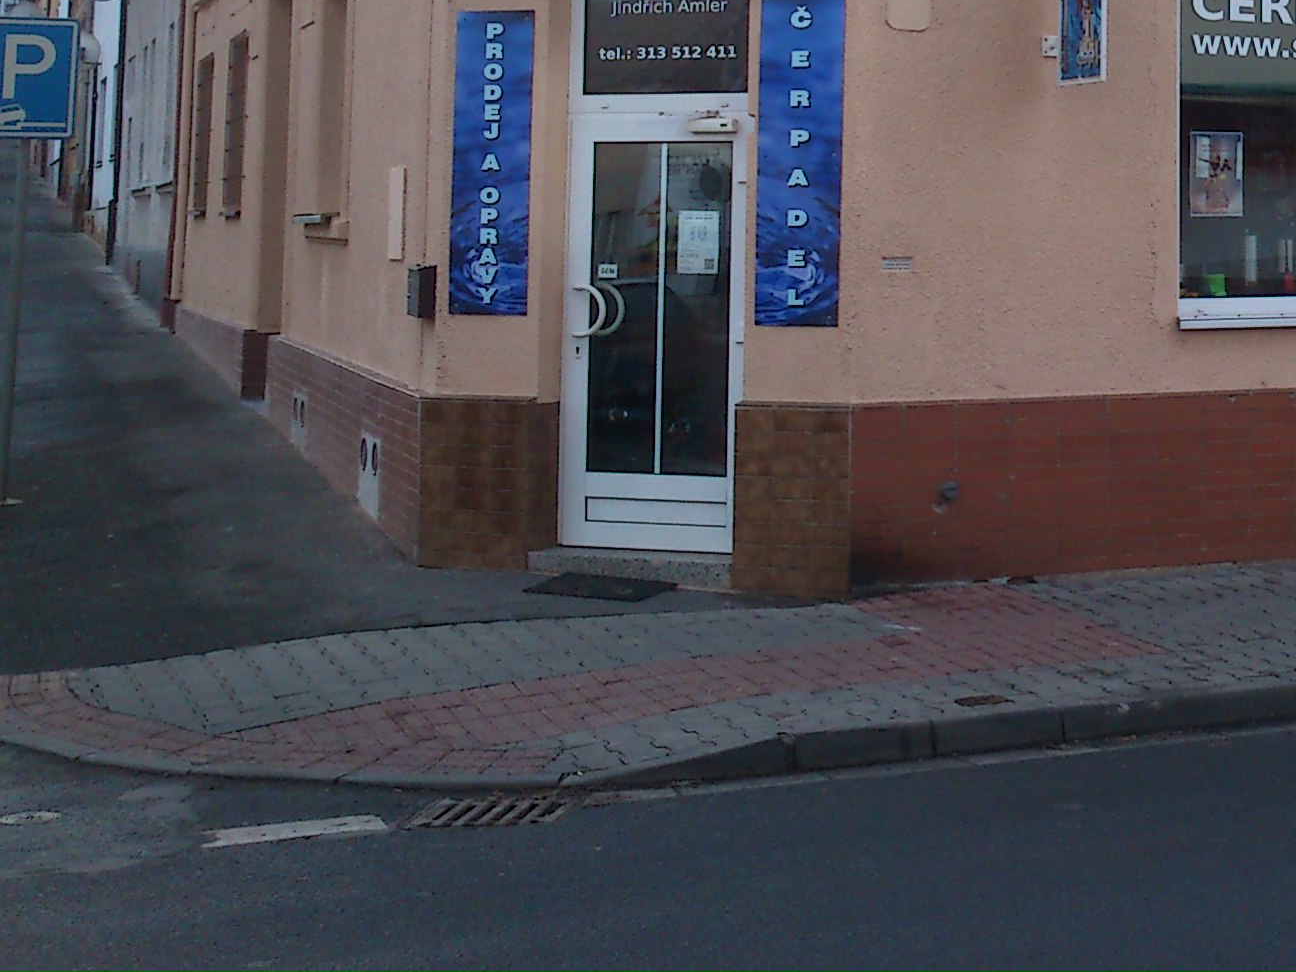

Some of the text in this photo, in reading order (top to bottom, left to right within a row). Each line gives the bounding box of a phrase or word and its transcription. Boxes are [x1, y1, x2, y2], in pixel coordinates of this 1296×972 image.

[2, 34, 57, 100] P
[599, 45, 737, 60] tel.: 313 512 411
[478, 22, 504, 304] PRODEJ A OPRAVY
[786, 4, 811, 306] ČERPADEL
